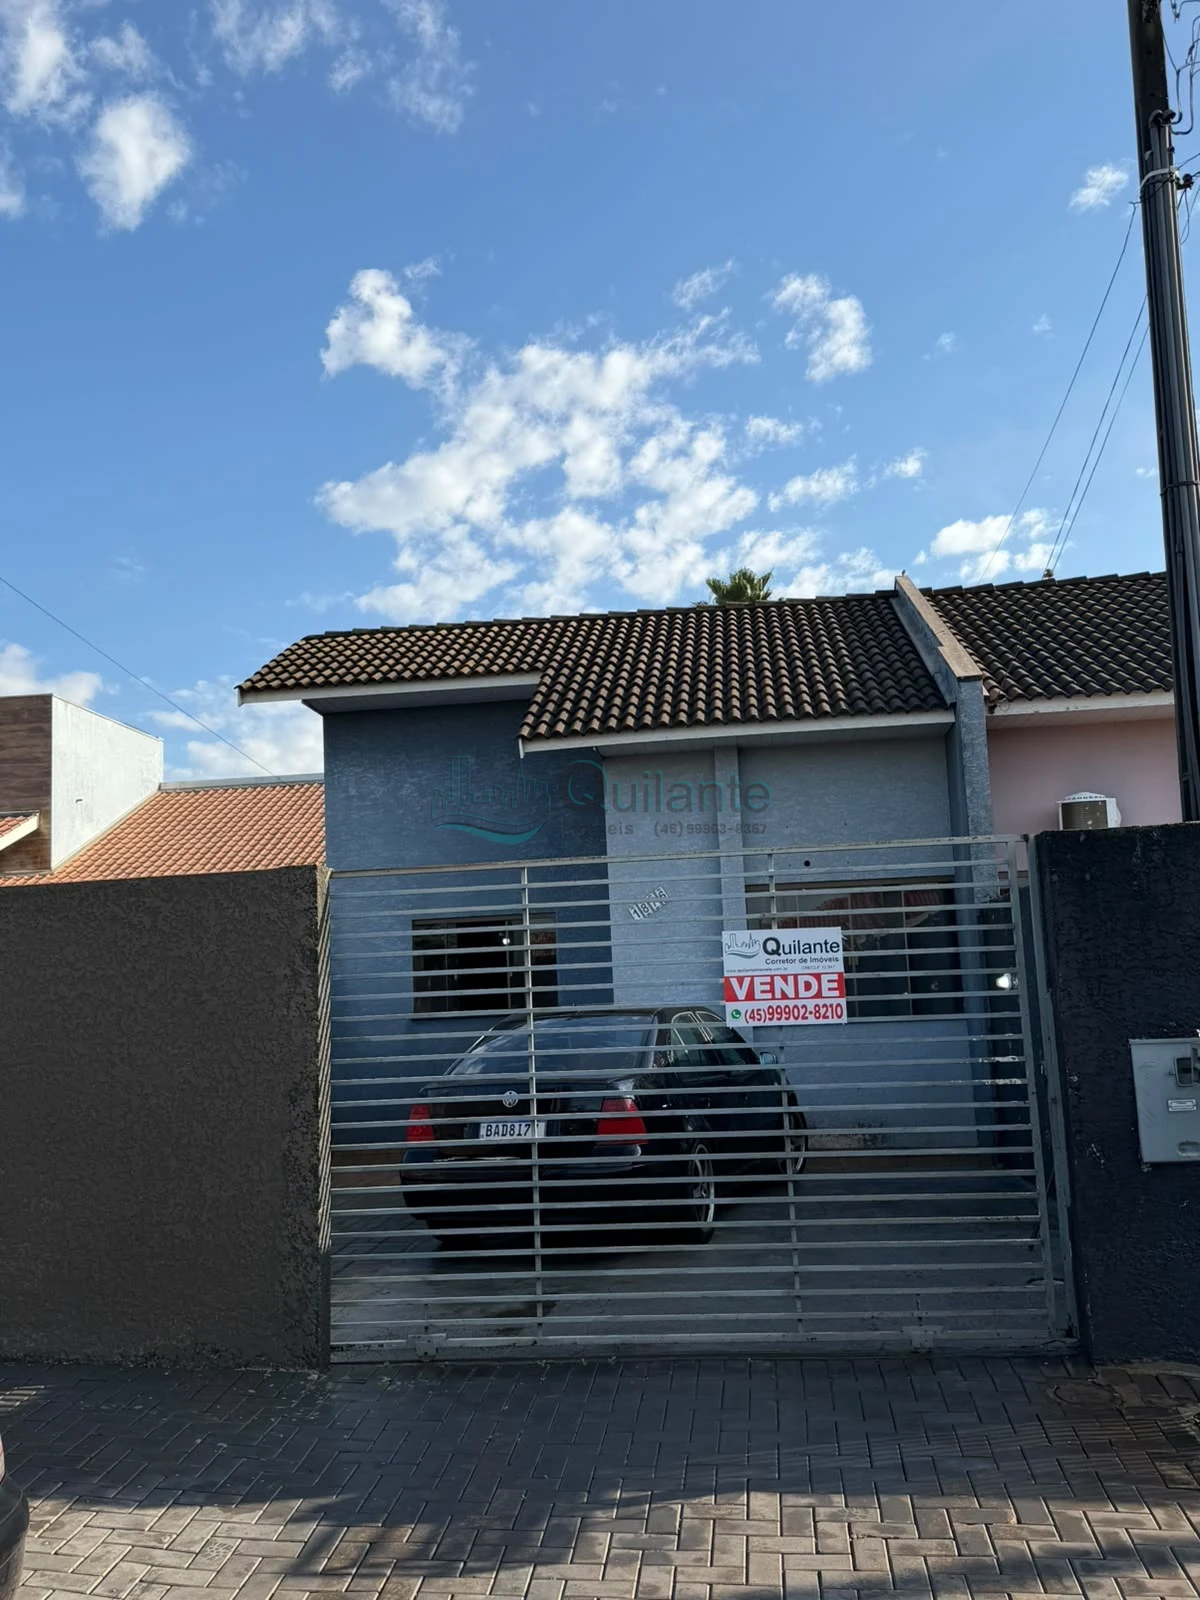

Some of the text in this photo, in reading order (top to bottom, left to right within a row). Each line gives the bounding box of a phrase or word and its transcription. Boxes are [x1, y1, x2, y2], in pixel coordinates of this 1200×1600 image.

[762, 937, 840, 956] Quilante
[765, 955, 840, 965] Corretor de Imóveis
[729, 974, 840, 1001] VENDE
[744, 1003, 844, 1024] (45)99902-8210
[486, 1123, 540, 1137] BAD8I7
